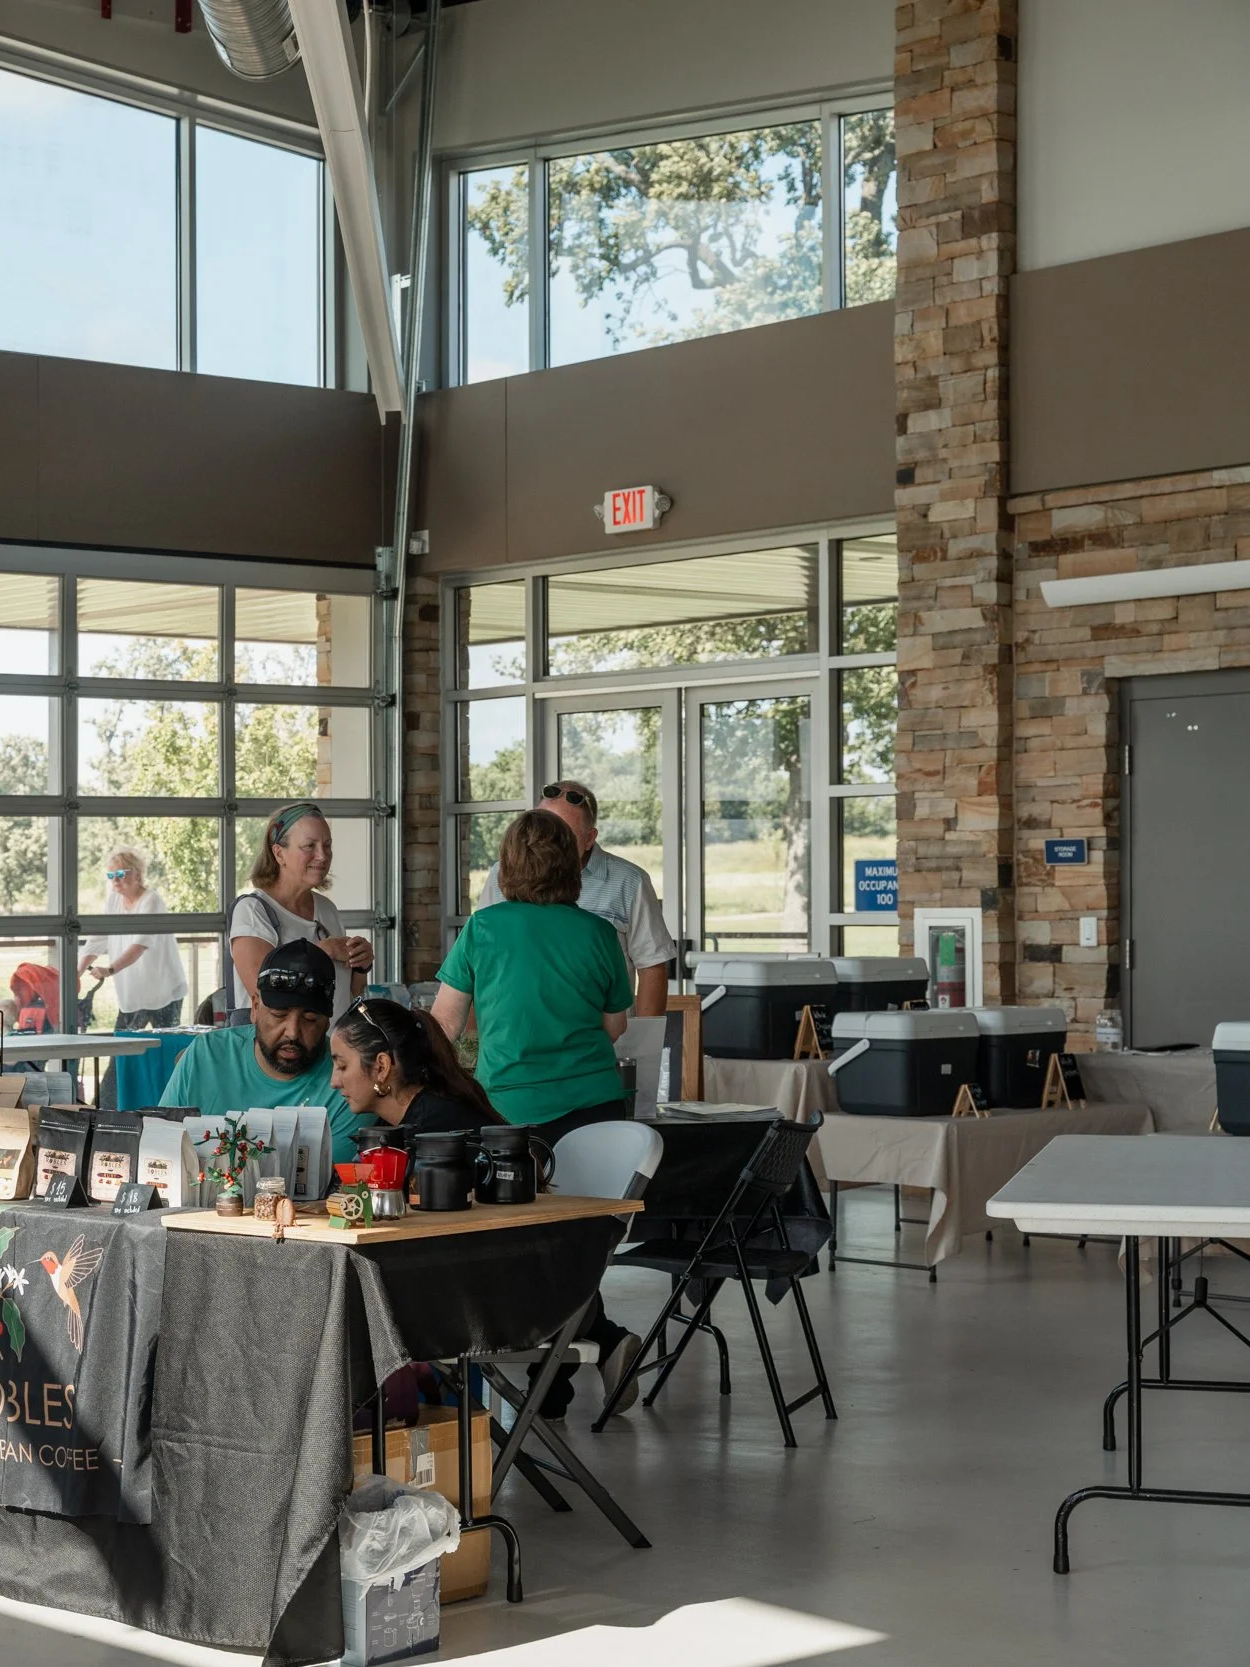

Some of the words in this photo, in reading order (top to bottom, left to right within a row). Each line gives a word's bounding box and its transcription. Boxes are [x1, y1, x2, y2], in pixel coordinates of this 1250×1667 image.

[612, 489, 646, 526] EXIT
[864, 866, 898, 877] MAXIMU
[858, 880, 899, 891] OCCUPAN
[876, 893, 894, 905] 100
